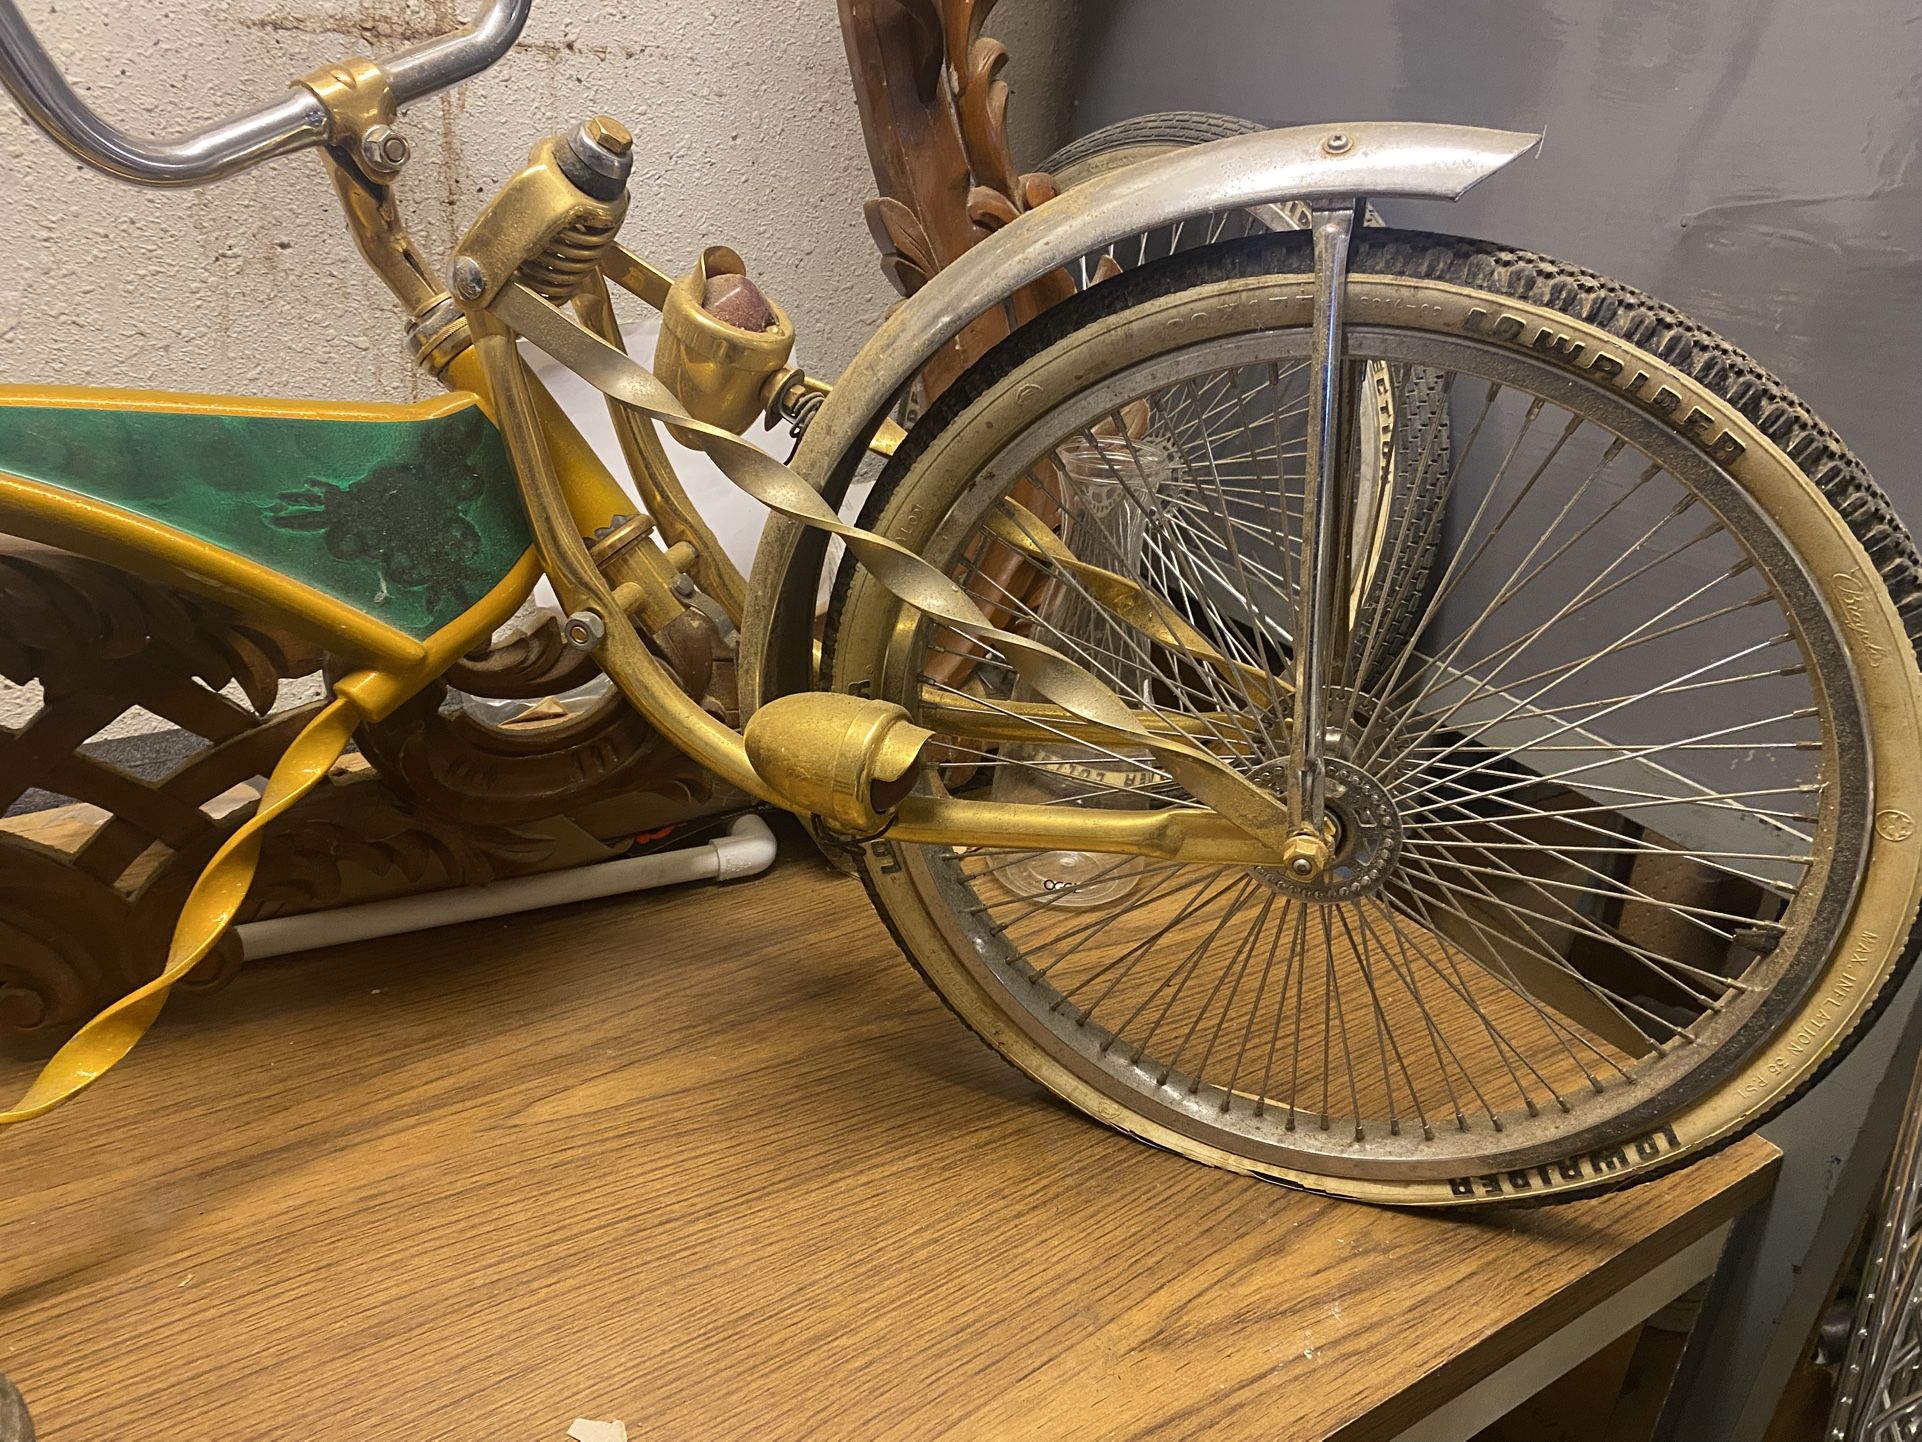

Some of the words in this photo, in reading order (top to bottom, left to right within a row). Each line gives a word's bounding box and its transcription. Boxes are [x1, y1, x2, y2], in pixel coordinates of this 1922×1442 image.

[1463, 307, 1746, 466] LOWRIDER
[1847, 930, 1879, 969] MAX.
[1787, 972, 1857, 1057] INFLATION
[1767, 1056, 1790, 1077] 35
[1449, 1123, 1682, 1197] LOWRIDER
